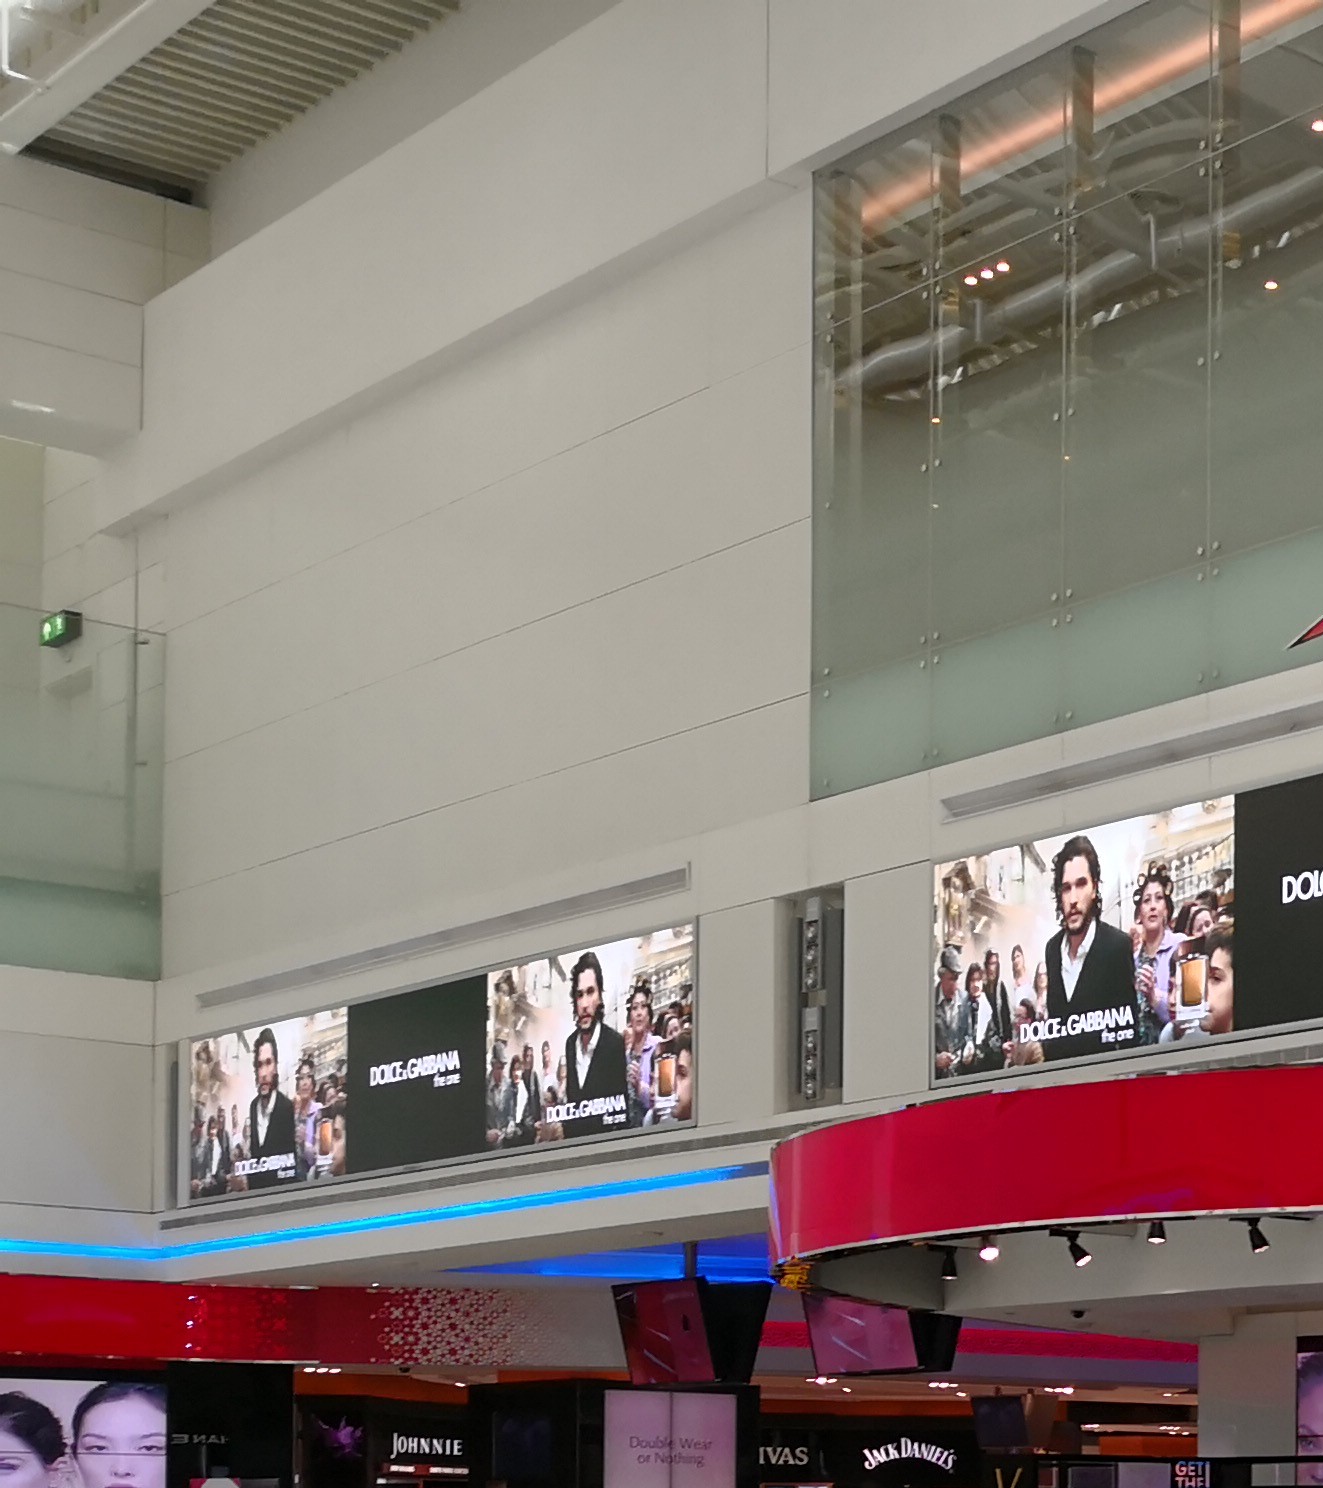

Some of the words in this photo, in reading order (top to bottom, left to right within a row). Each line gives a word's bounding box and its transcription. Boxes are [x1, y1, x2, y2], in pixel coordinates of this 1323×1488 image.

[1019, 1017, 1061, 1044] DOLCE
[1067, 1004, 1134, 1038] GABBANA
[1117, 1028, 1134, 1041] one
[369, 1062, 402, 1087] DOLCE
[407, 1050, 461, 1079] GABBANA
[546, 1101, 576, 1124] DOLCE
[579, 1094, 627, 1118] GABBANA
[390, 1432, 464, 1459] JOHNNIE
[629, 1435, 675, 1450] Double
[679, 1437, 713, 1450] Wear
[862, 1442, 900, 1470] JACK
[900, 1437, 958, 1470] DANIEL'S
[636, 1454, 651, 1464] or
[654, 1451, 705, 1468] Nothing
[758, 1446, 810, 1466] IVAS
[1174, 1461, 1205, 1477] GET
